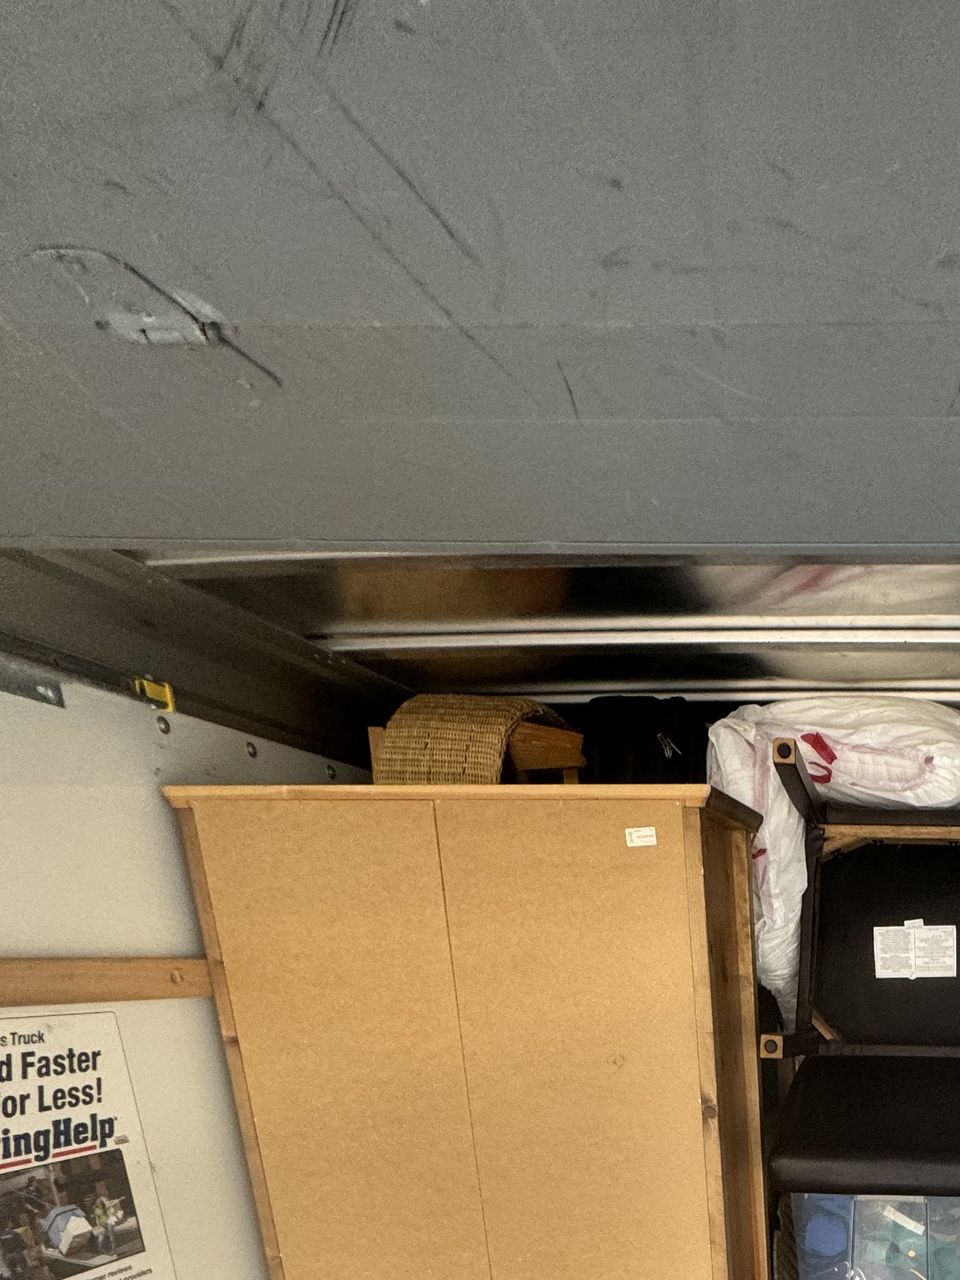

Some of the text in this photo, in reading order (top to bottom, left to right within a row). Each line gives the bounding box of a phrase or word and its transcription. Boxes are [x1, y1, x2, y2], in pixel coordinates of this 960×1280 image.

[10, 1029, 45, 1046] Truck
[21, 1048, 101, 1080] Faster
[38, 1077, 102, 1113] Less!
[107, 1265, 132, 1278] reviews
